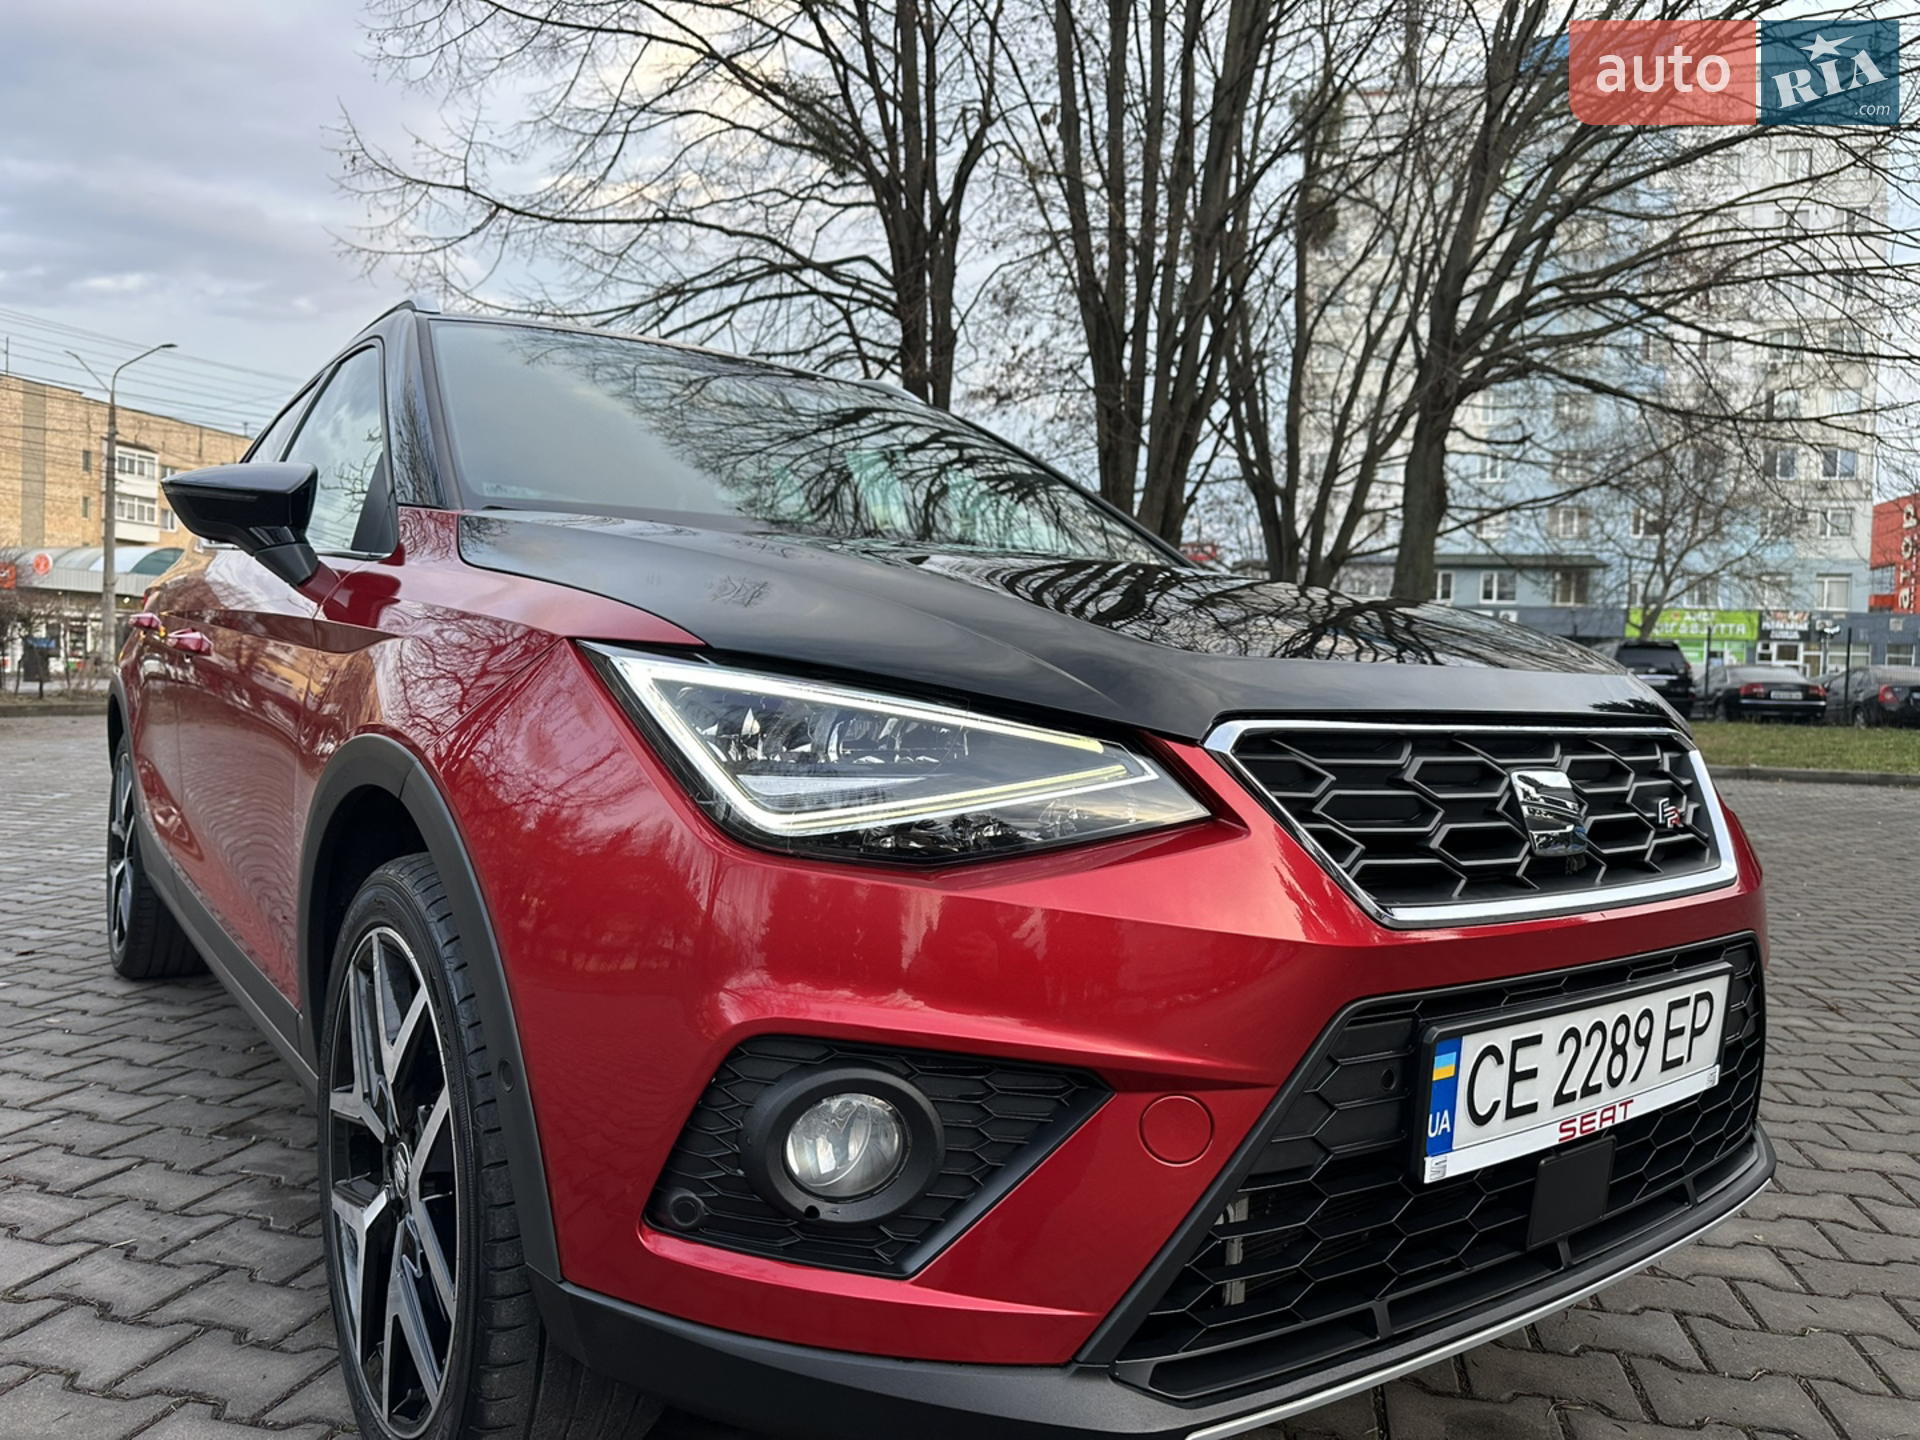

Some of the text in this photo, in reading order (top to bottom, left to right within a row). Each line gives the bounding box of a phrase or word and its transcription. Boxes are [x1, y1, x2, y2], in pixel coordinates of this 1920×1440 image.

[1466, 990, 1714, 1126] CE 2289 EP
[1428, 1109, 1451, 1138] UA
[1558, 1100, 1634, 1143] SEAT
